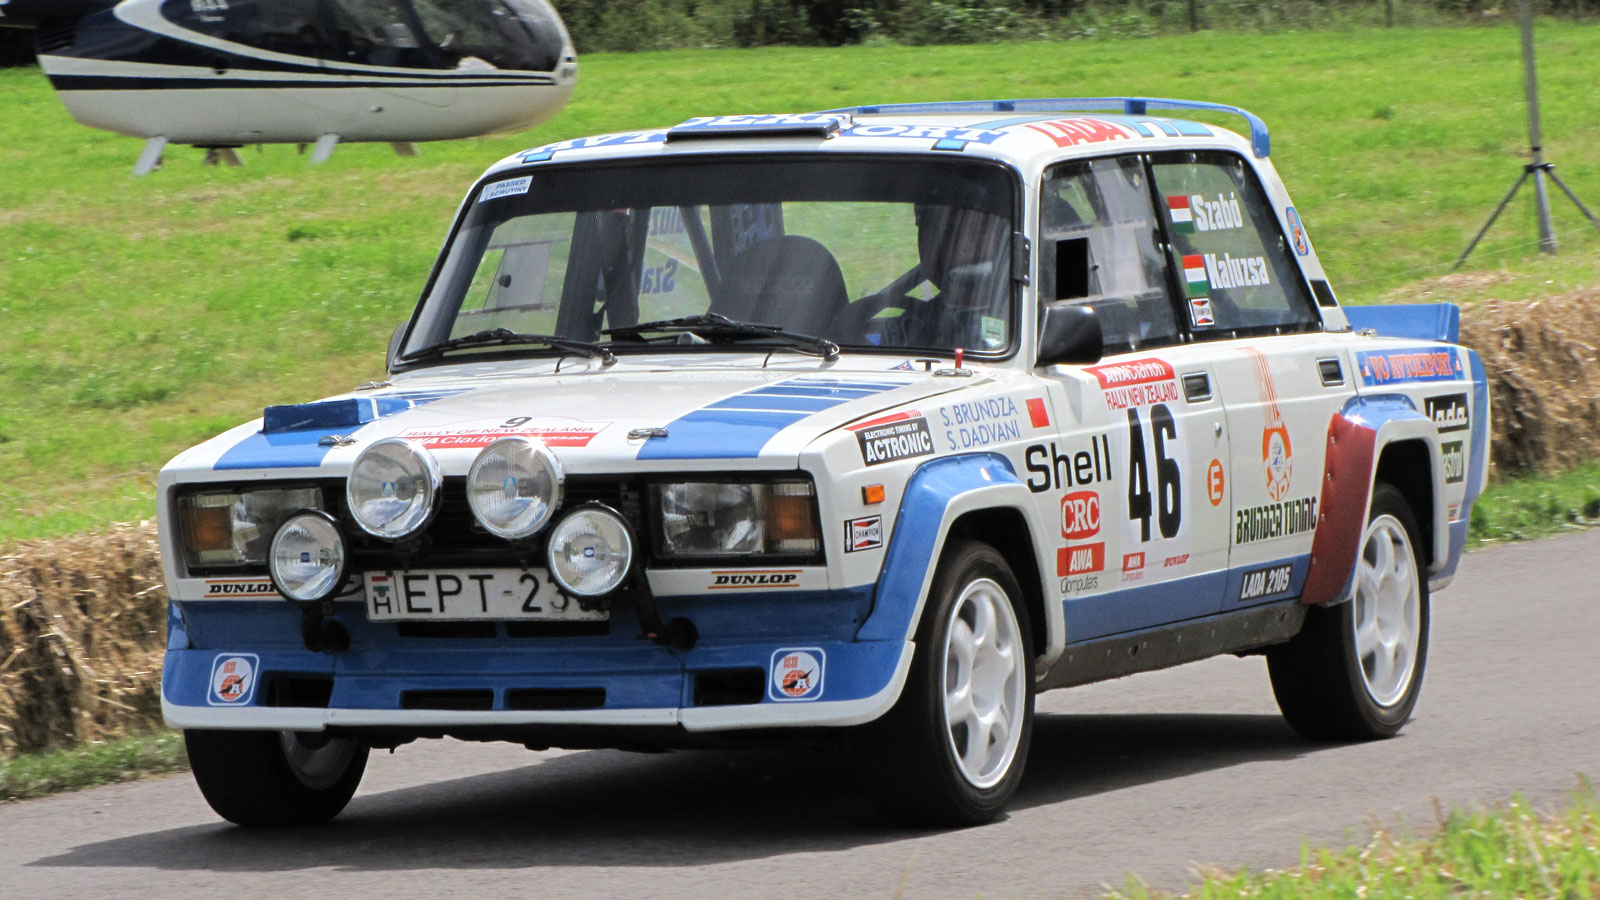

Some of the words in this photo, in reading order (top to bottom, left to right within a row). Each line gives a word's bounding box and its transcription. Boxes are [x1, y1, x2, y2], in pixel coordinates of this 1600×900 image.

[1025, 117, 1131, 148] LADA
[489, 186, 528, 198] SCRUTINY
[496, 180, 526, 189] PASSED
[1191, 192, 1243, 231] Szabó
[1204, 252, 1271, 290] Kaluzsa
[1387, 352, 1454, 379] AVTOEXPORT
[1105, 388, 1129, 411] RALLY
[1127, 386, 1146, 406] NEW
[1145, 382, 1179, 404] ZEALAND
[499, 416, 533, 428] 9
[940, 406, 954, 427] S.
[953, 396, 1018, 425] BRUNDZA
[864, 426, 896, 440] ELECTRONIC
[894, 423, 912, 434] TIMING
[911, 422, 919, 431] BY
[946, 430, 960, 450] S.
[959, 419, 1021, 448] DADVANI
[866, 431, 931, 462] ACTRONIC
[1025, 433, 1112, 494] Shell
[1127, 403, 1182, 543] 46
[1210, 465, 1222, 501] E
[1061, 497, 1100, 535] CRC
[855, 527, 879, 540] CHAMPION
[1069, 548, 1093, 571] AWA
[1126, 555, 1141, 569] AWA
[1163, 553, 1191, 568] DUNLOP
[714, 574, 797, 585] DUNLOP
[1060, 576, 1099, 596] Computers
[1241, 571, 1267, 599] LADA
[1265, 566, 1292, 594] 2105
